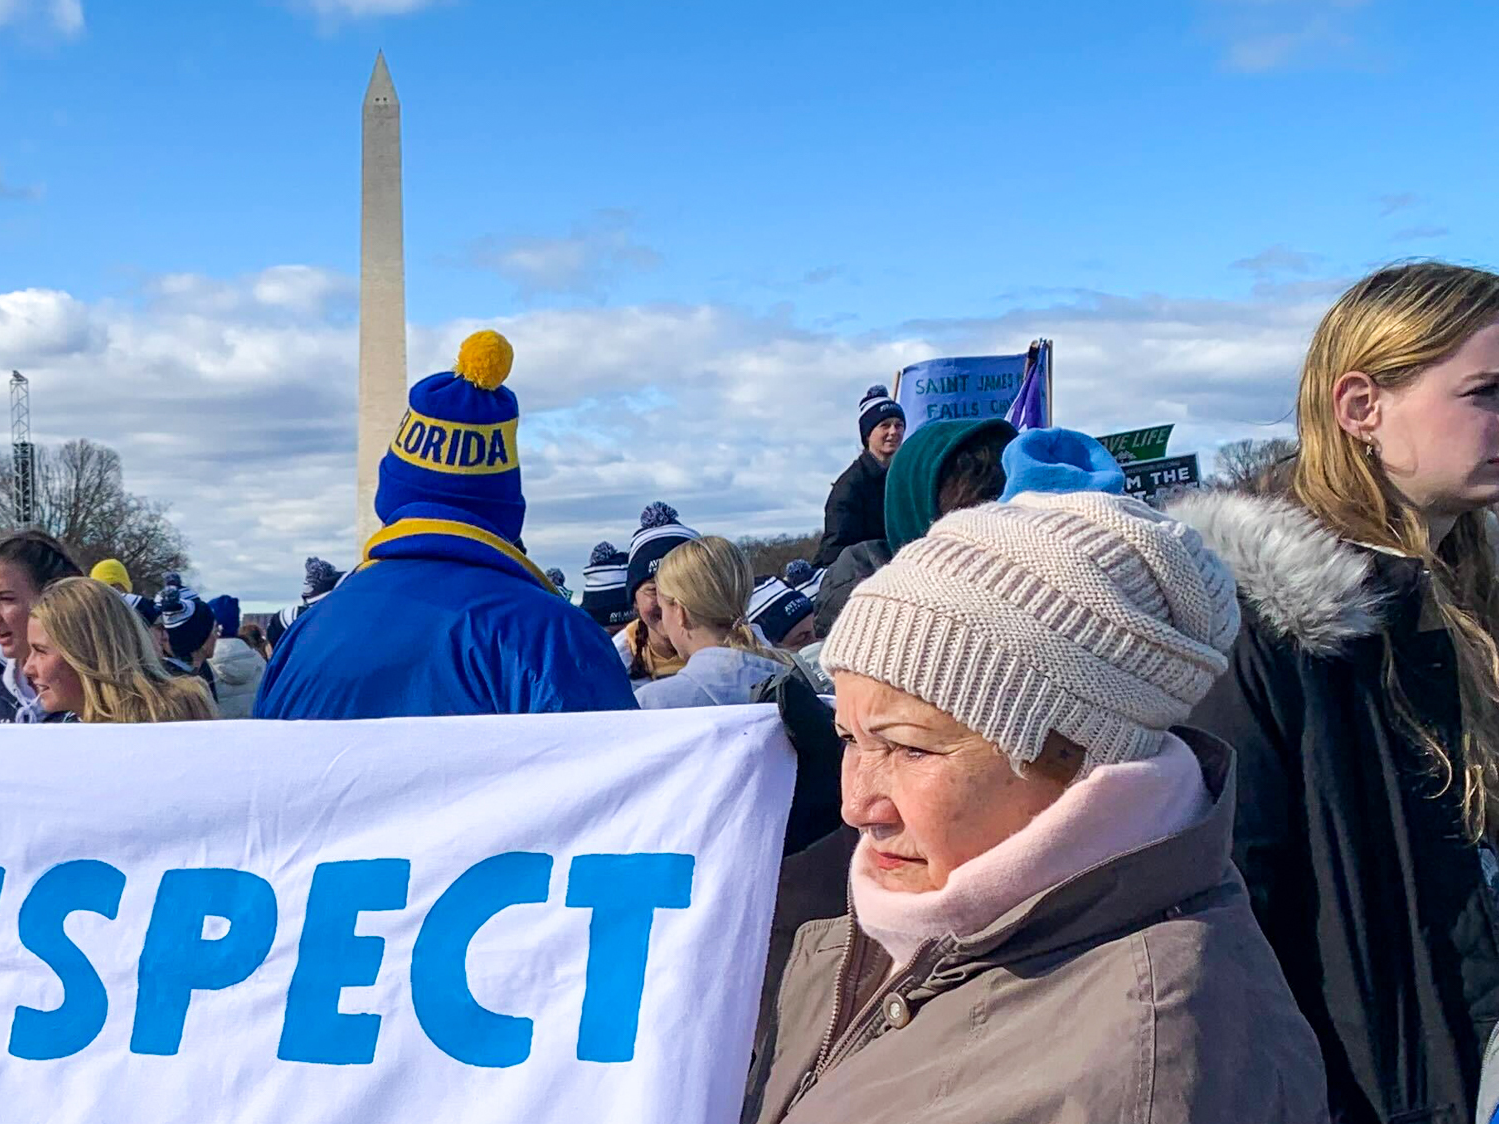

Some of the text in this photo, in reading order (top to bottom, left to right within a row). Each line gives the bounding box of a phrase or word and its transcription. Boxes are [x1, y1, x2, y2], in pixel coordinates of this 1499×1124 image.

[915, 374, 970, 395] SAINT
[977, 373, 1013, 392] JAMES
[926, 401, 980, 419] FALLS
[395, 408, 509, 467] LORIDA
[1132, 427, 1170, 448] LIFE
[1149, 466, 1191, 485] THE
